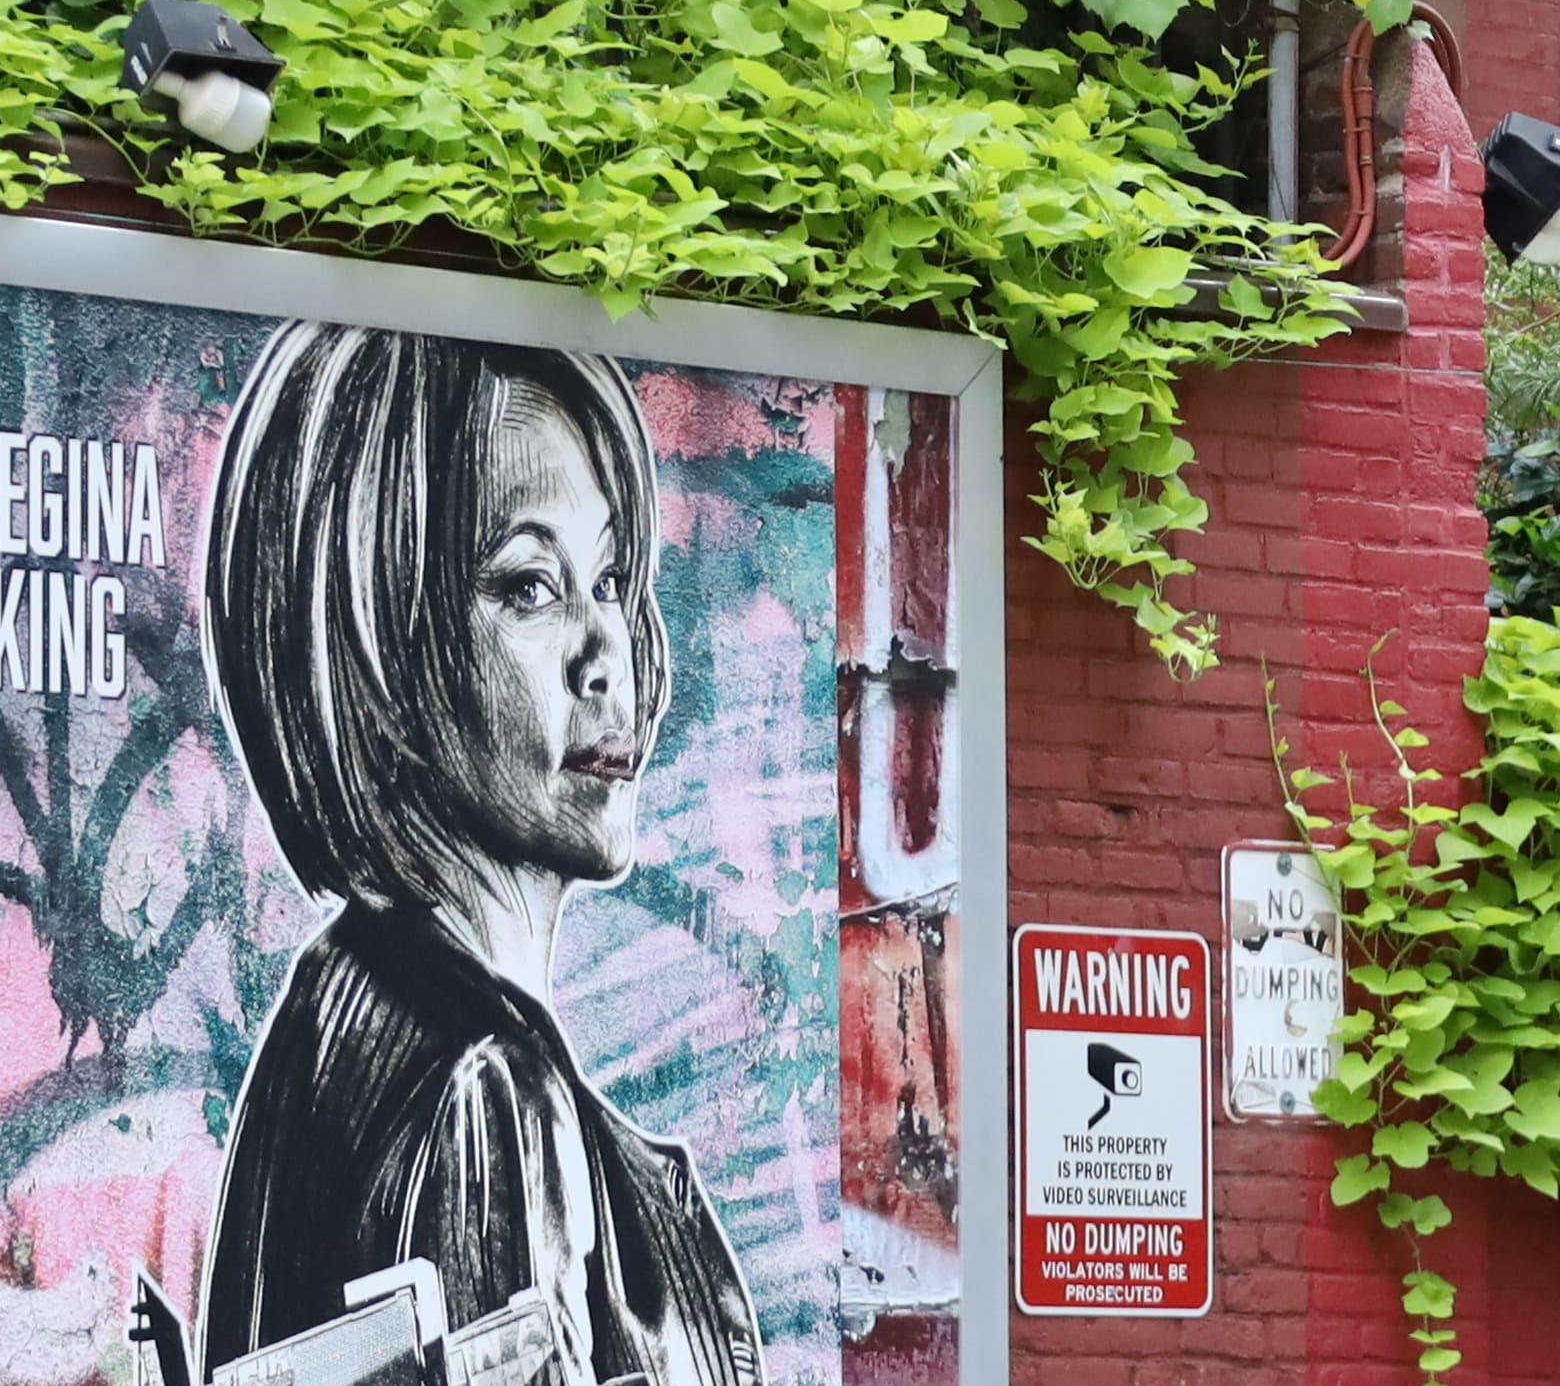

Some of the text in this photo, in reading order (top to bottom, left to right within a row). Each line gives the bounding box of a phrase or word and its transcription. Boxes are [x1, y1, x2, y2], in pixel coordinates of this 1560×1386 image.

[1268, 888, 1304, 921] NO
[1033, 948, 1192, 1020] WARNING
[1235, 967, 1339, 1003] DUMPING
[1244, 1045, 1332, 1081] ALLOWED
[1063, 1136, 1168, 1157] THIS PROPERTY
[1058, 1161, 1174, 1182] IS PROTECTED BY
[1043, 1186, 1188, 1208] VIDEO SURVEILLANCE
[1045, 1222, 1184, 1257] NO DUMPING
[1041, 1261, 1188, 1281] VIOLATORS WILL BE
[1065, 1284, 1163, 1303] PROSECUTED
